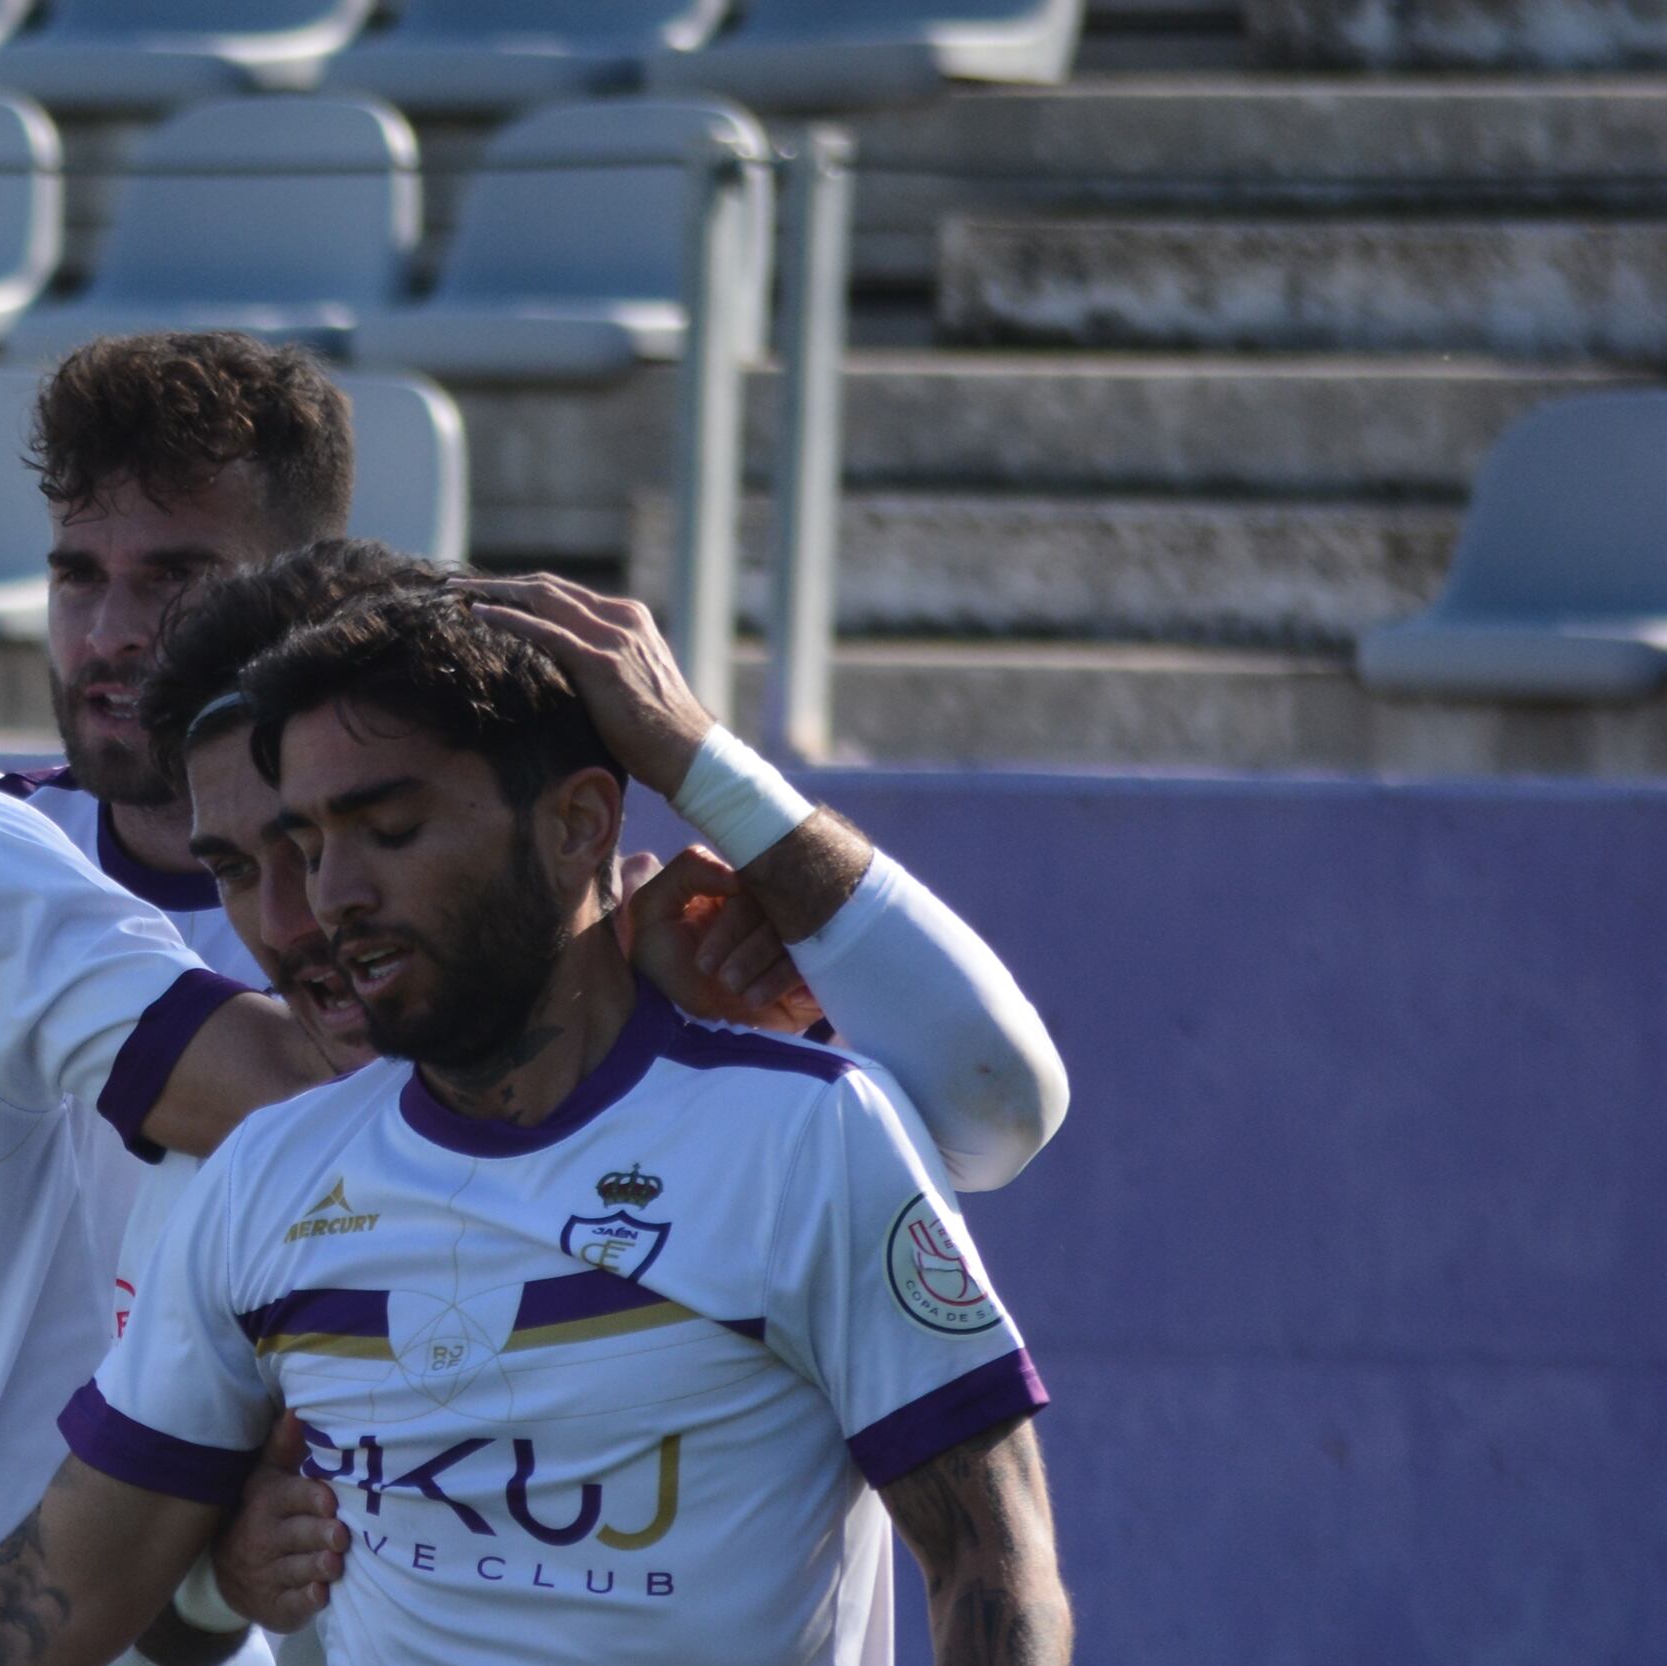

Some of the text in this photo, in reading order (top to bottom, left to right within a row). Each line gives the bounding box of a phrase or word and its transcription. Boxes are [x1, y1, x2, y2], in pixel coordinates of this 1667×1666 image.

[283, 1213, 381, 1244] MERCURY
[592, 1226, 639, 1240] JAÉN
[906, 1280, 939, 1316] COPA
[946, 1312, 969, 1322] DE
[362, 1530, 675, 1597] VECLUB
